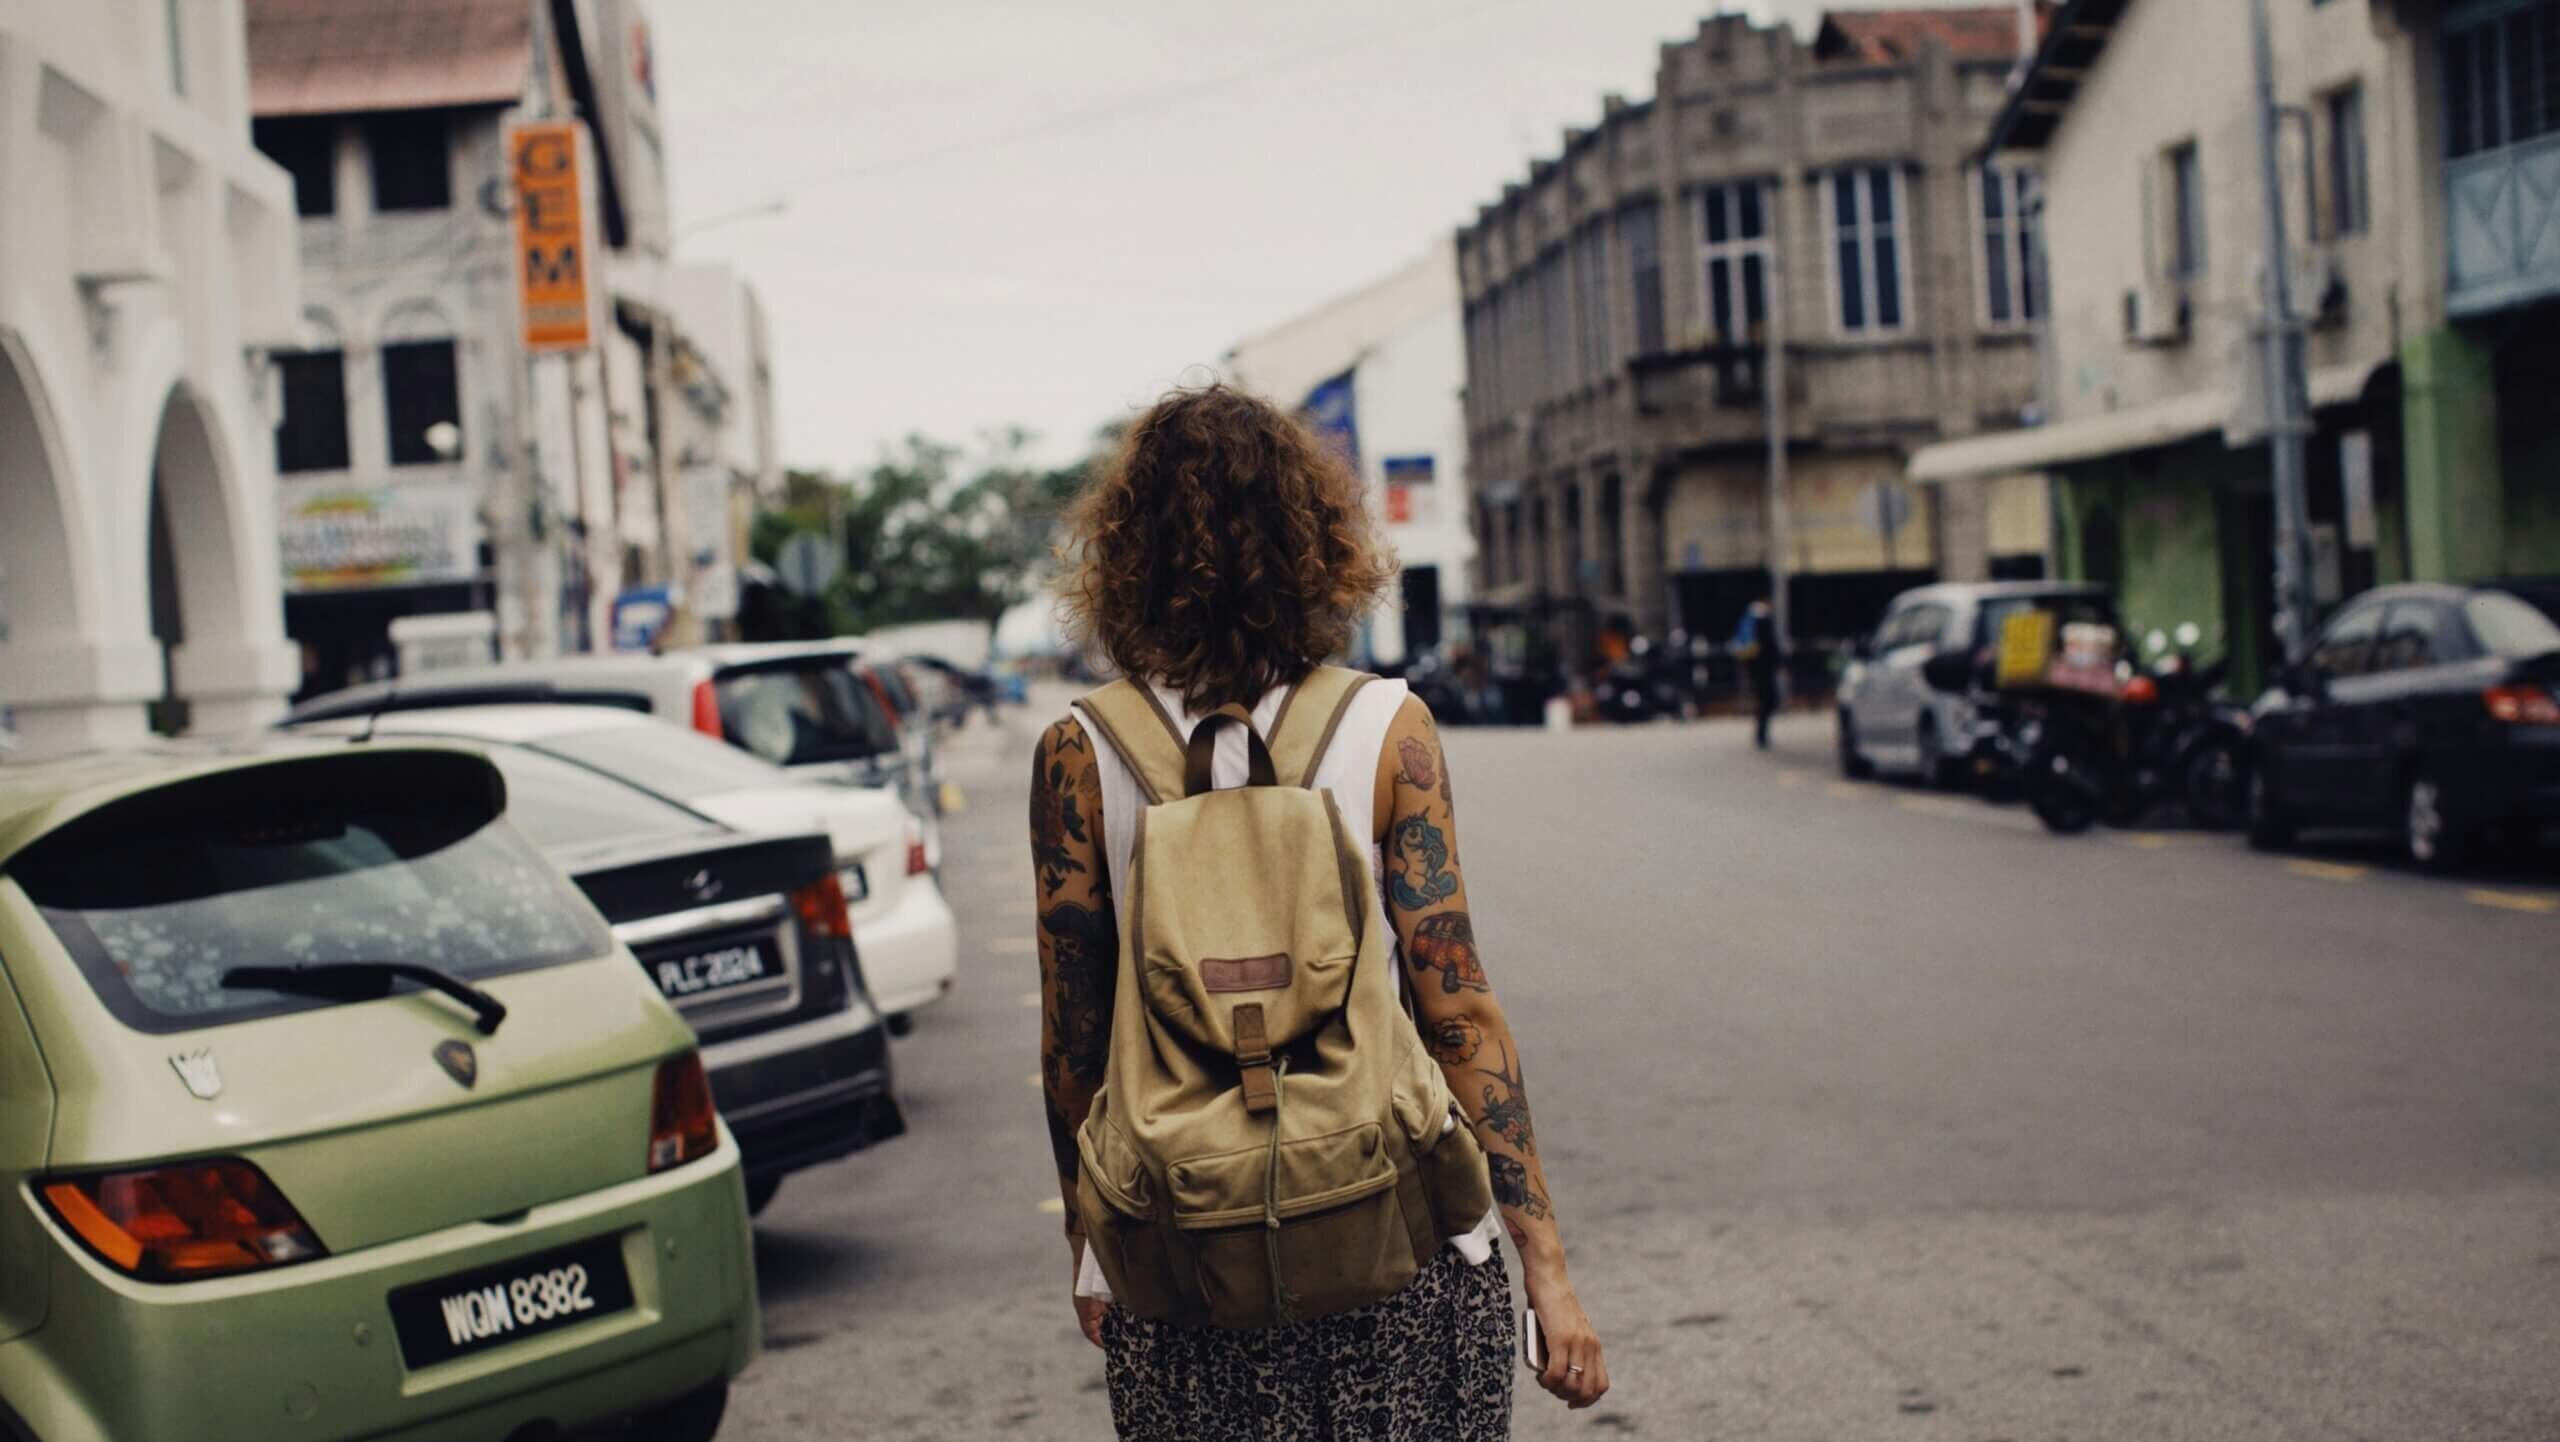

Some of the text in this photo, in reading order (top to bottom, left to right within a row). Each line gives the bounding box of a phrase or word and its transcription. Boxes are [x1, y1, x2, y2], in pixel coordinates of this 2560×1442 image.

[520, 131, 579, 288] GEM
[440, 1263, 595, 1345] WQM 8382
